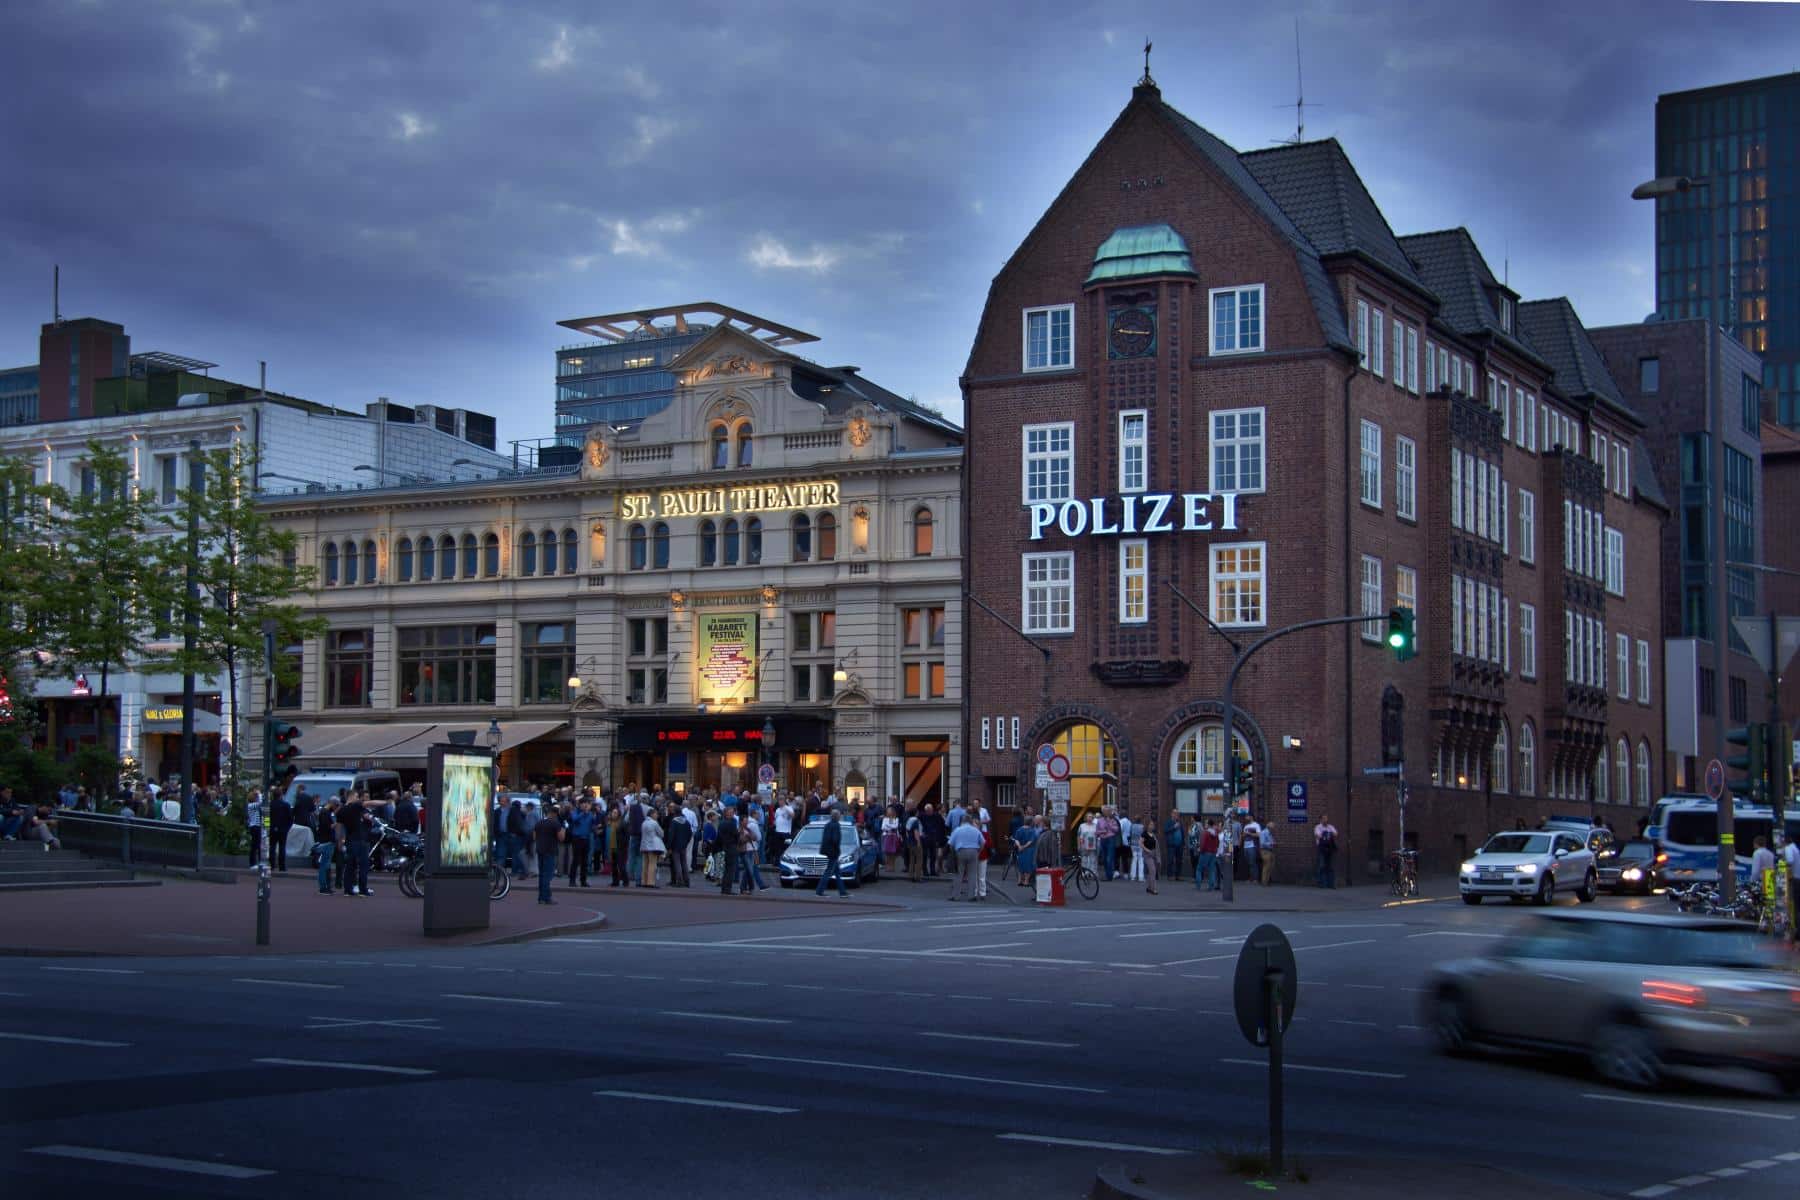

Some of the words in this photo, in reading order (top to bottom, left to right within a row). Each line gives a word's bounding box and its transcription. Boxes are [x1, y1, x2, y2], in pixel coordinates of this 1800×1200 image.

[622, 493, 656, 520] ST.
[660, 488, 725, 517] PAULI
[730, 481, 839, 512] THEATER
[1030, 493, 1238, 540] POLIZEI
[707, 623, 747, 632] KABARETT
[710, 631, 744, 639] FESTIVAL
